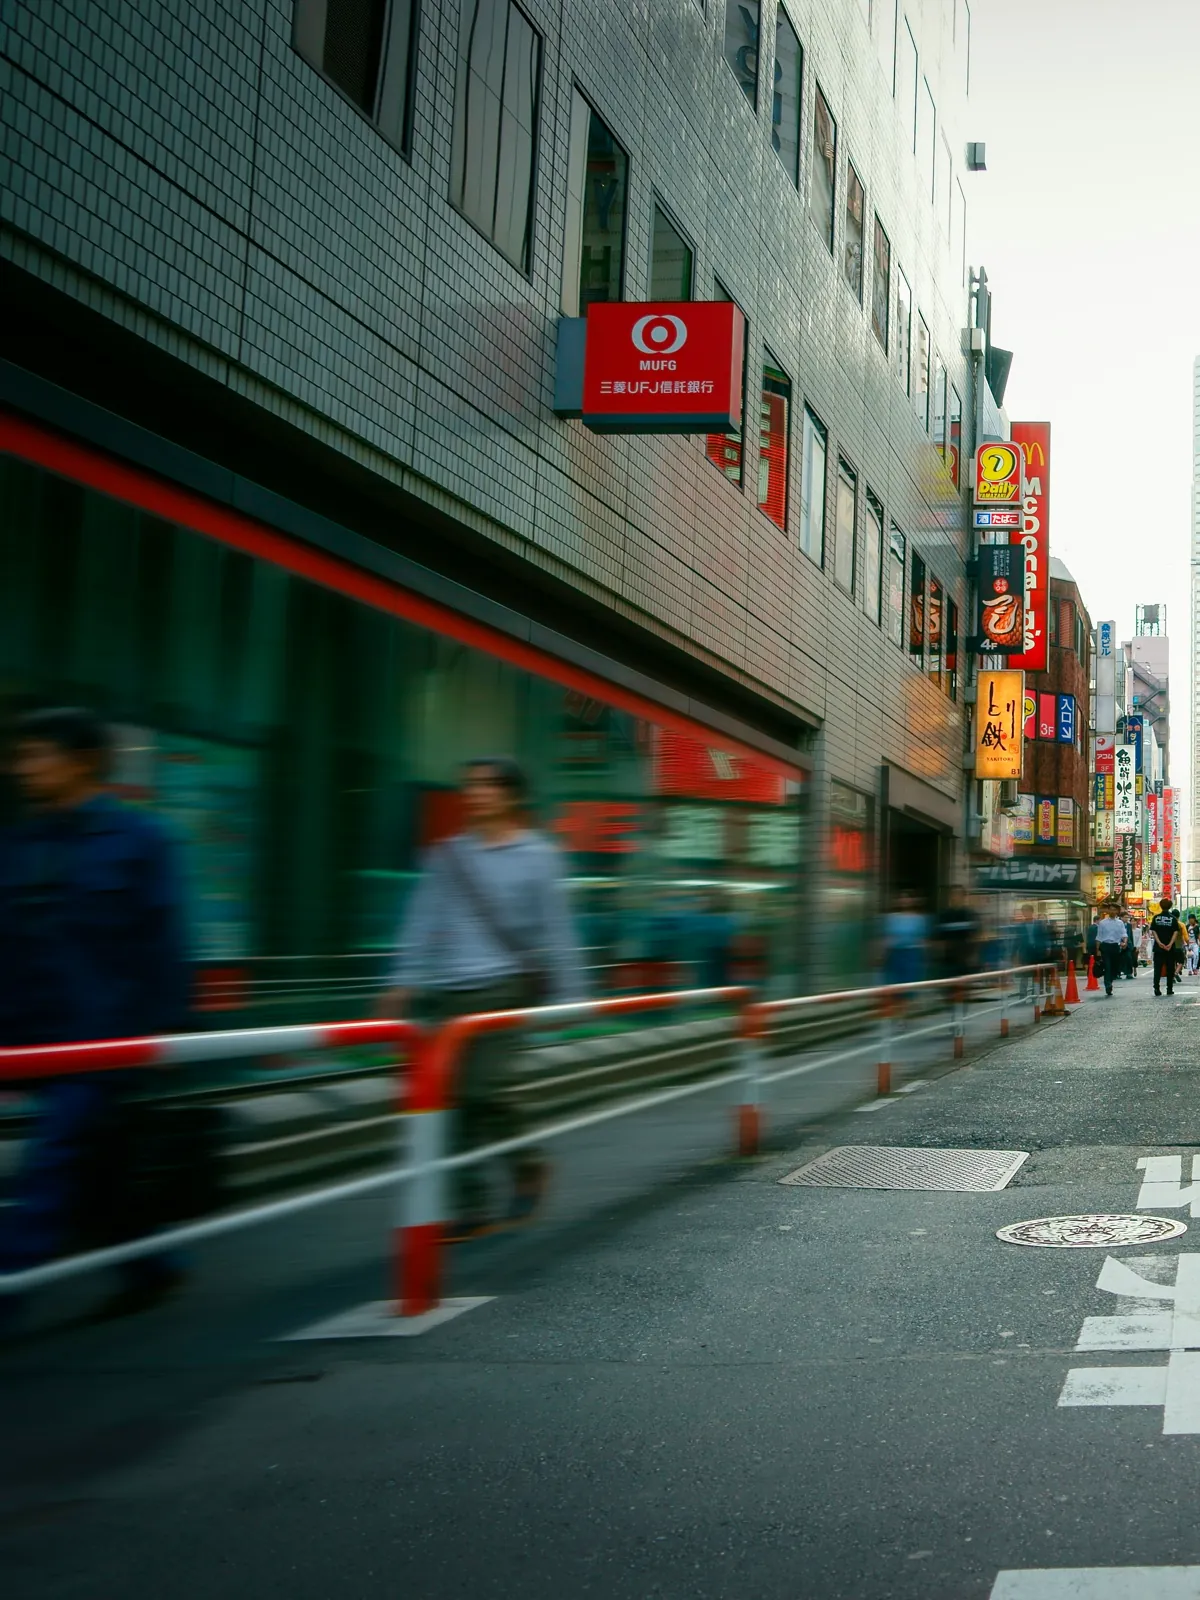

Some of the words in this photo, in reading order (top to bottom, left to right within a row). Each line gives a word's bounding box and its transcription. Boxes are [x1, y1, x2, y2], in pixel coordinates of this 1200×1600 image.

[639, 360, 677, 371] MUFG
[600, 380, 714, 394] 三菱UFJ信託銀行
[978, 515, 990, 524] 酒
[992, 514, 1018, 524] たばこ
[1019, 477, 1042, 650] McDonald's
[980, 639, 998, 650] 4F
[1101, 623, 1111, 656] 桑原ビル
[981, 681, 1016, 751] とり鉄
[1061, 698, 1072, 723] 入口
[1040, 723, 1054, 736] 3F
[1113, 834, 1124, 894] ヨドバシカメラ
